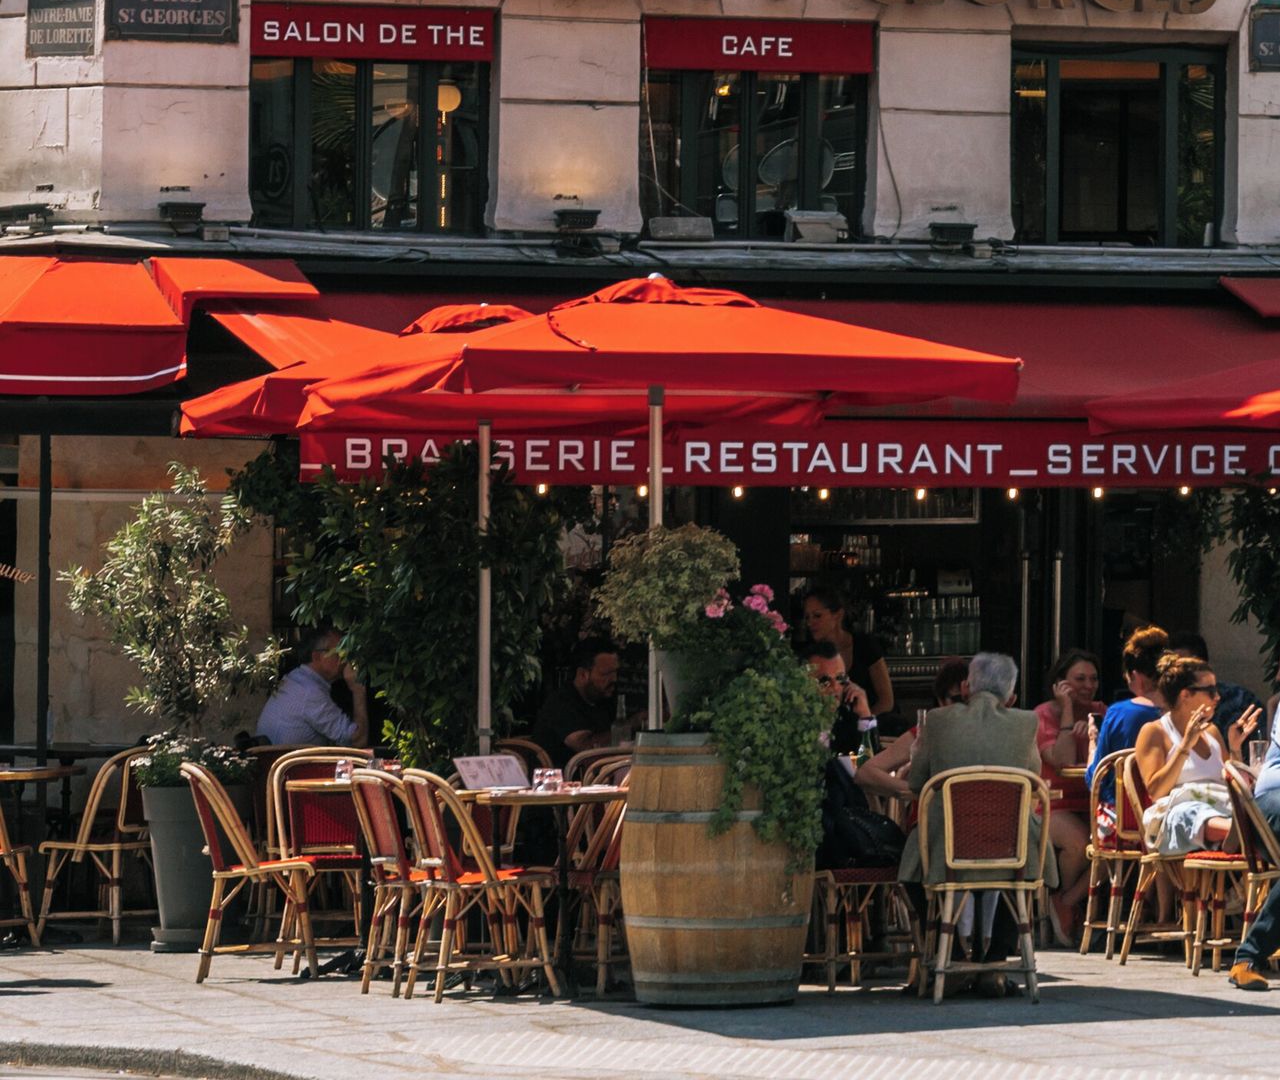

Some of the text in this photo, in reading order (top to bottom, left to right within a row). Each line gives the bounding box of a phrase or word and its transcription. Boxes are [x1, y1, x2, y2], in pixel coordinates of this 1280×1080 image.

[139, 7, 226, 27] GEORGES
[30, 27, 94, 46] DE LORETTE
[263, 21, 485, 46] SALON DE THE
[722, 35, 793, 57] CAFE
[345, 437, 636, 471] BRASERIE
[684, 441, 1003, 474] RESTAURANT
[1047, 443, 1248, 475] SERVICE
